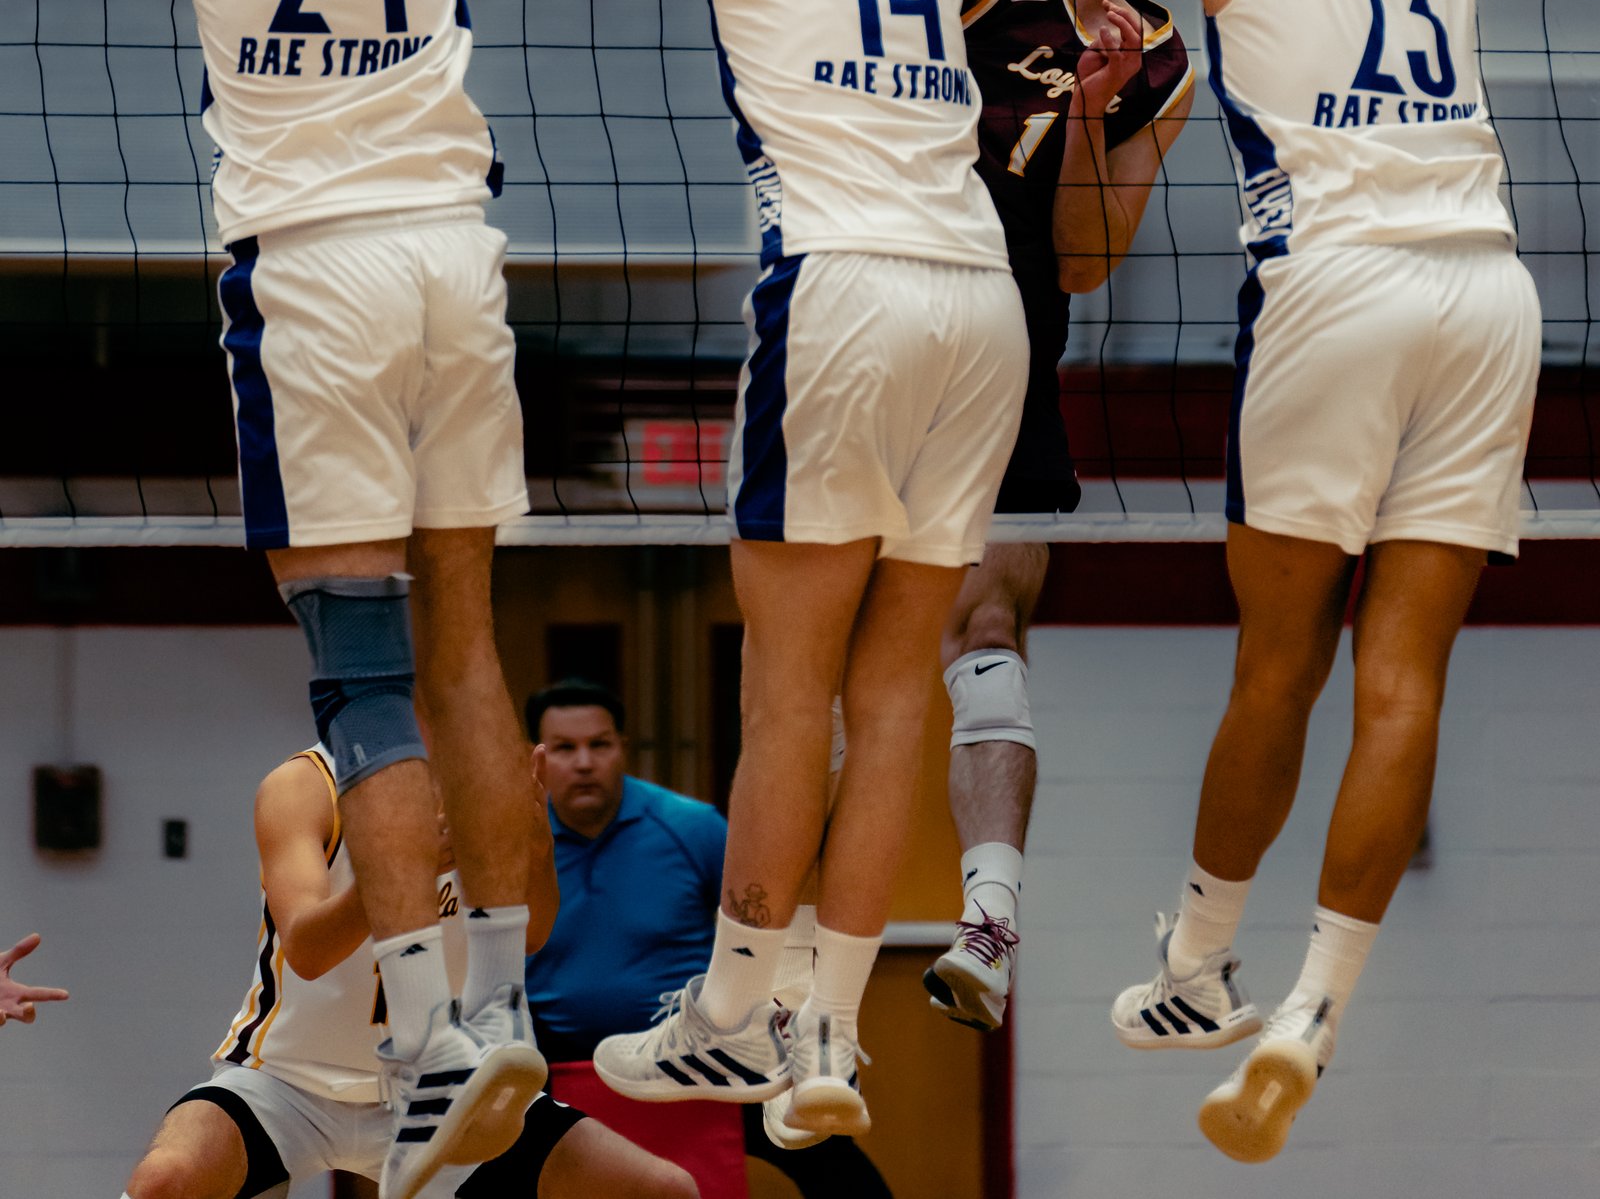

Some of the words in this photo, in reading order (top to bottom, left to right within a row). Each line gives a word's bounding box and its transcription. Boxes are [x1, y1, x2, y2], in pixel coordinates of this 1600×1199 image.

[236, 37, 306, 76] RAE
[813, 60, 878, 95] RAE
[892, 63, 972, 107] STRON
[1007, 110, 1060, 178] 1
